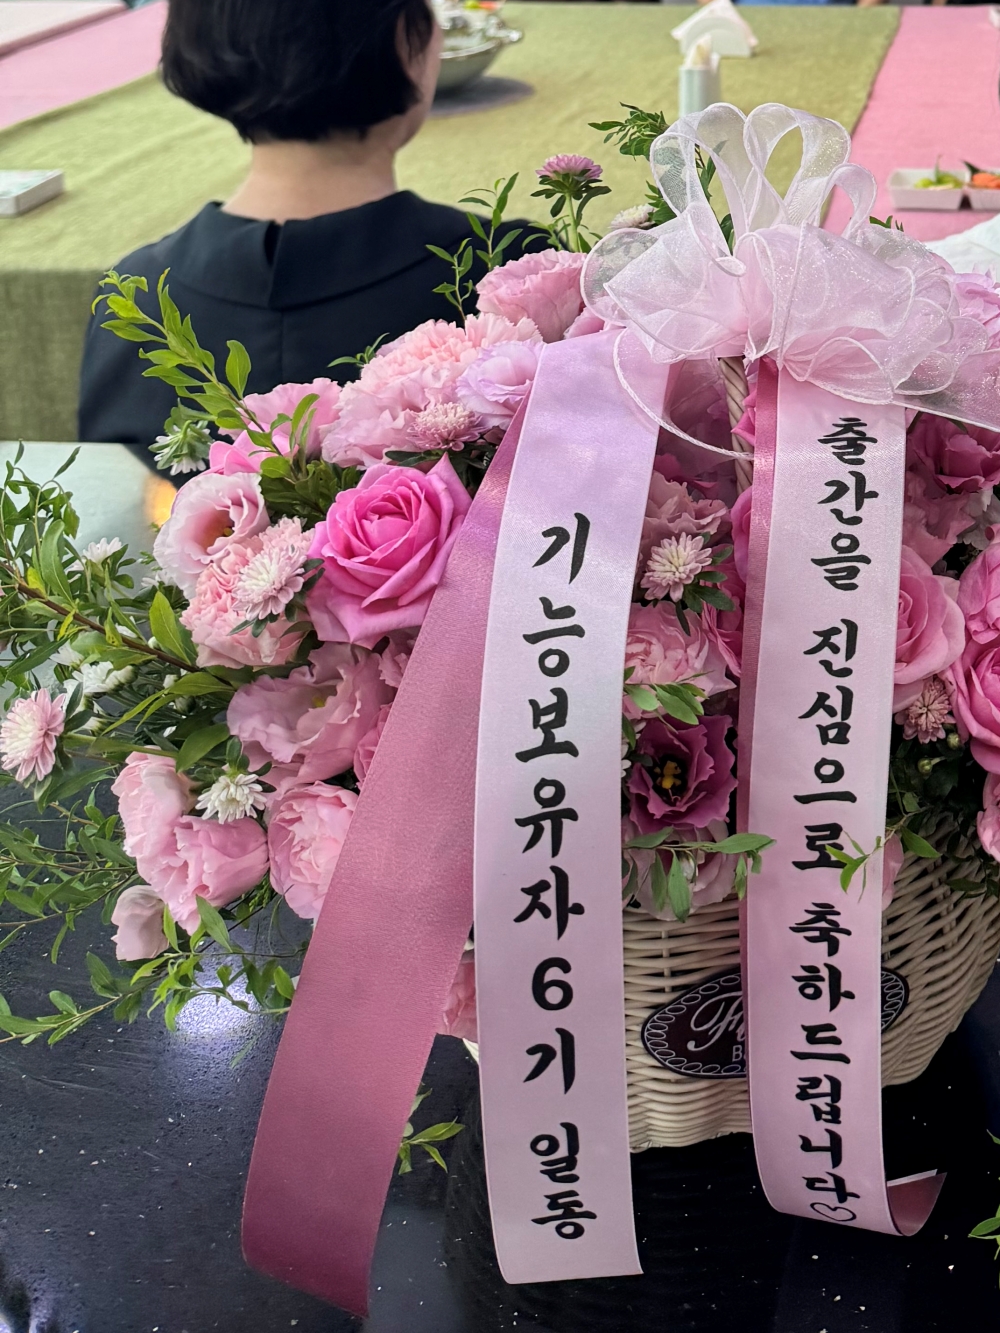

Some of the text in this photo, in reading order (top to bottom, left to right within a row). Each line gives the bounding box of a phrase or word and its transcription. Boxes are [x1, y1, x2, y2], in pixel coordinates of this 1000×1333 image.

[789, 417, 879, 1203] 출간을 진심으로 축하드립니다
[530, 1121, 598, 1240] 일동
